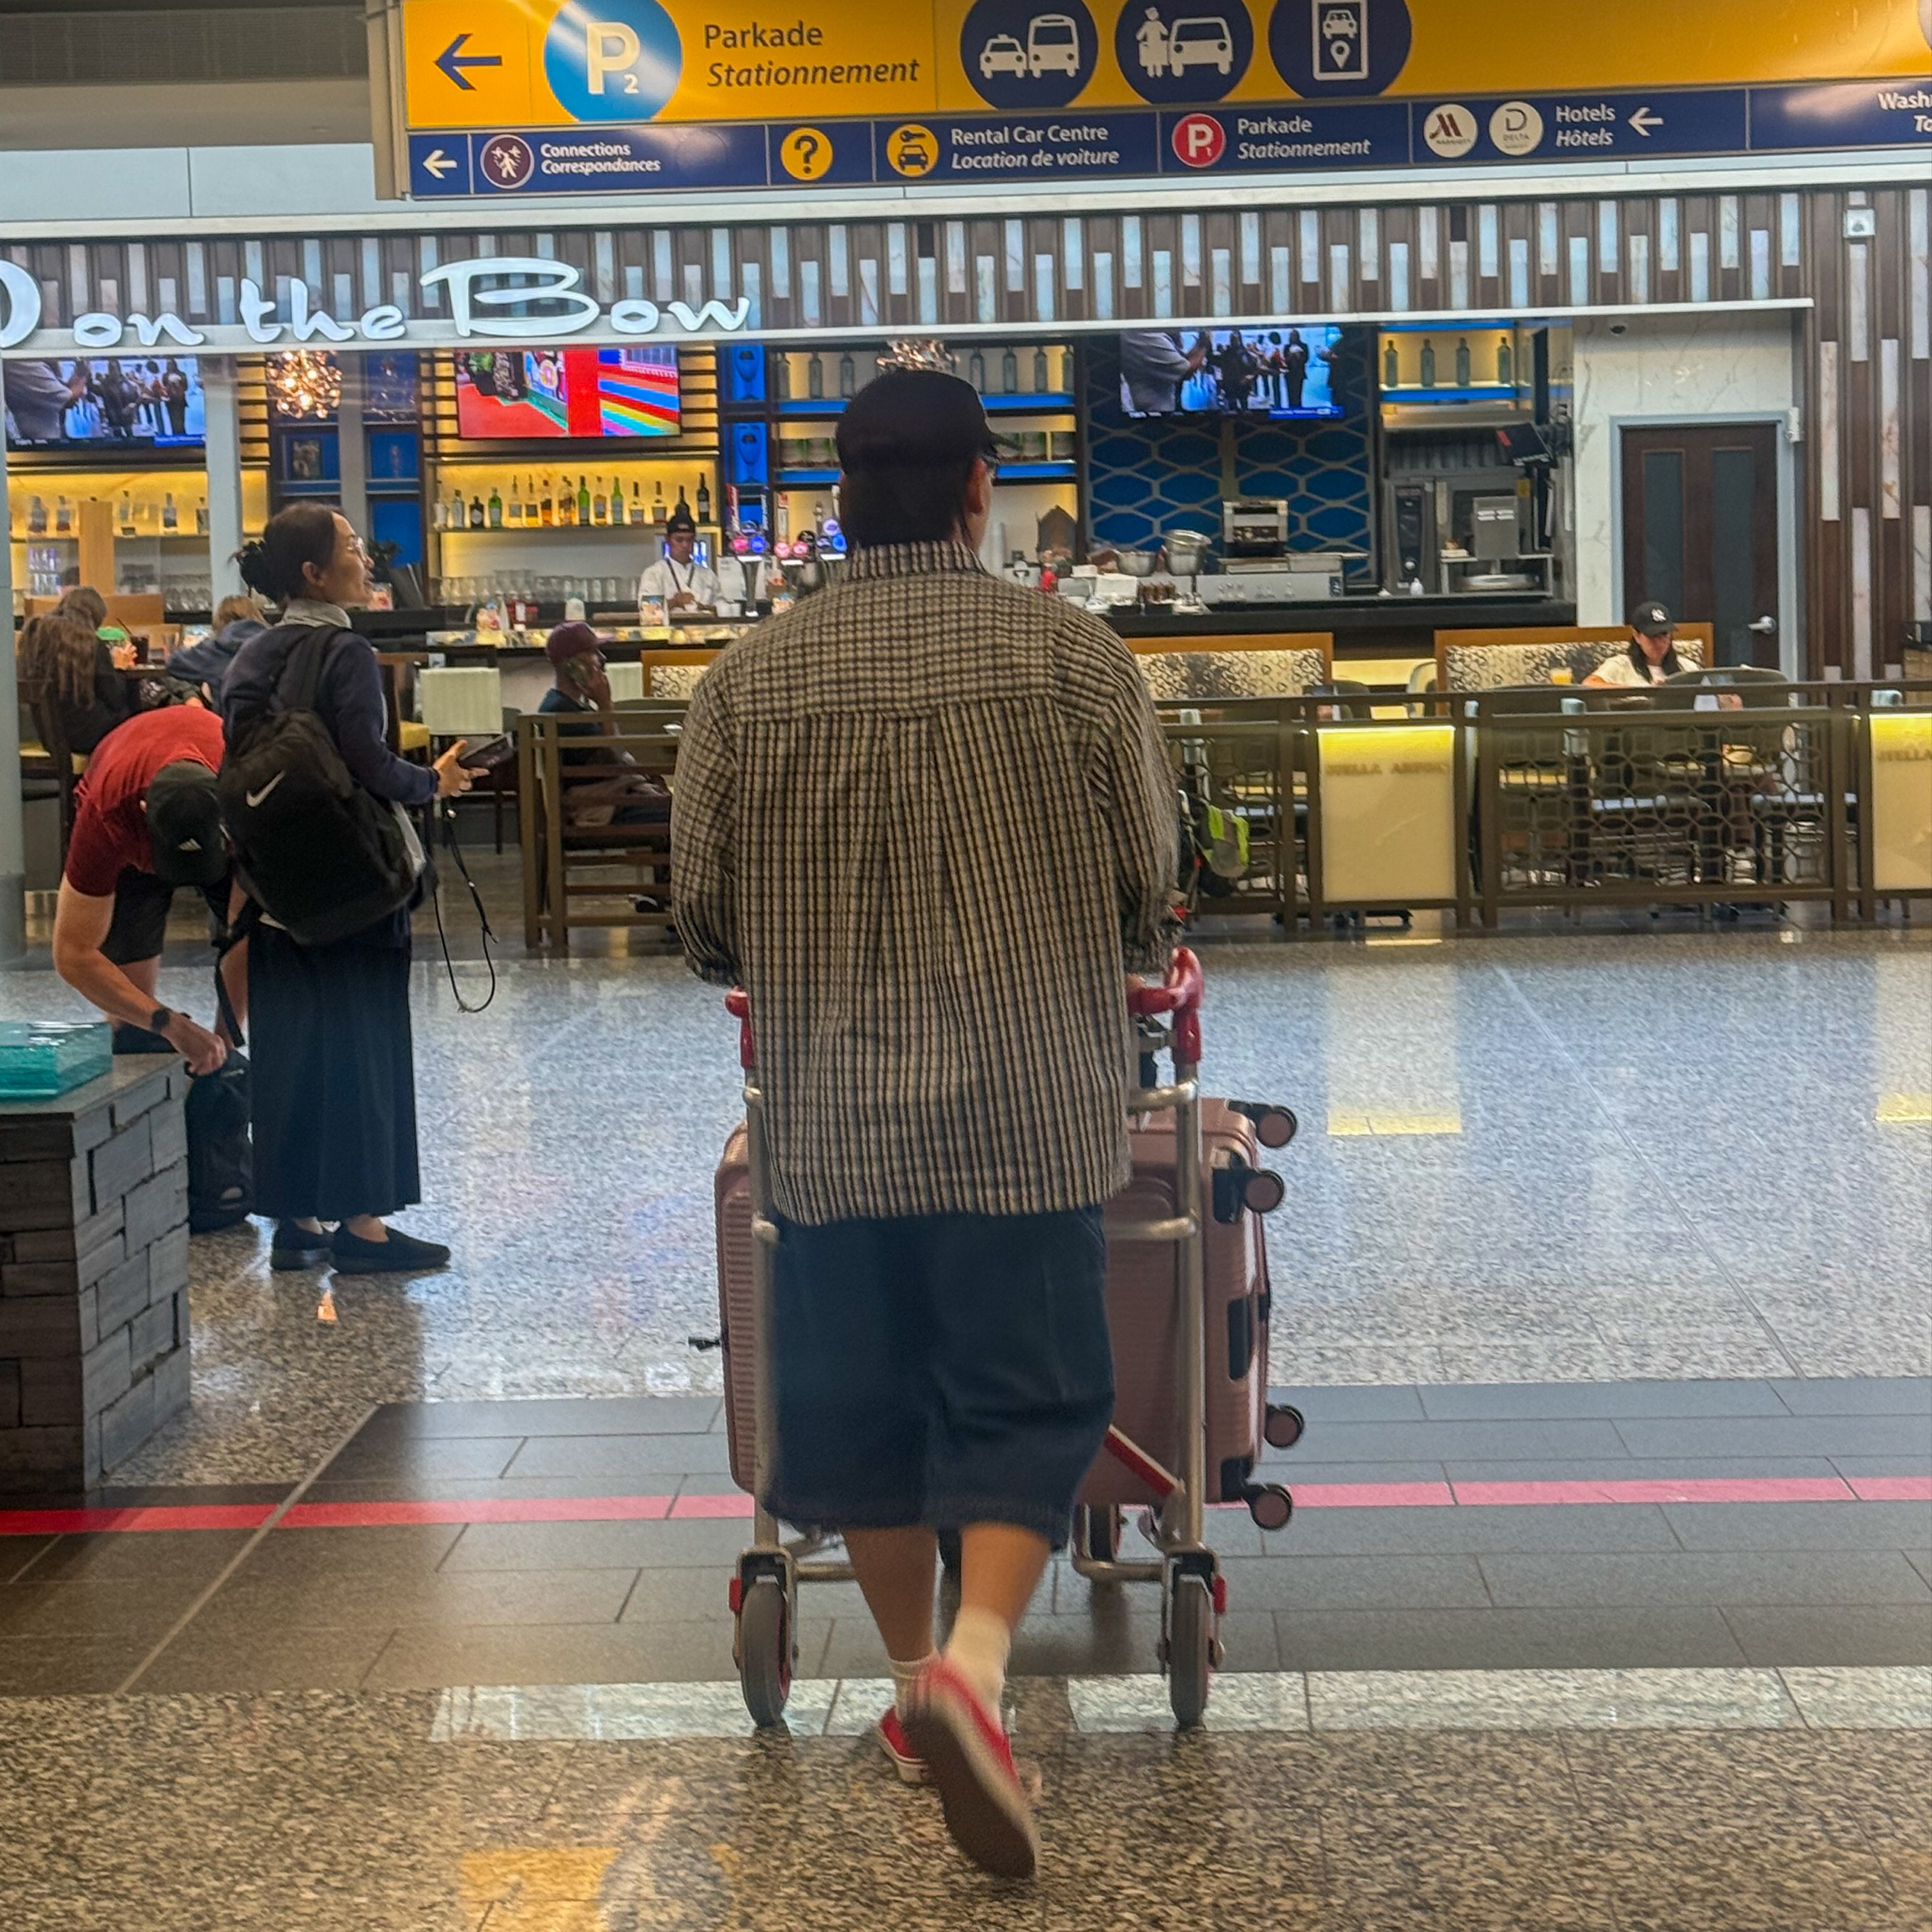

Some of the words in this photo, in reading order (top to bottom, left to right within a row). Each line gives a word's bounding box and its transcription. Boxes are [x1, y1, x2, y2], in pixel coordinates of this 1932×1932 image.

[704, 20, 823, 49] Parkade
[707, 59, 920, 88] Stationnement
[1877, 89, 1932, 110] Wash
[1555, 103, 1616, 123] Hotels
[951, 126, 1009, 146] Rental
[1013, 126, 1045, 143] Car
[1047, 124, 1109, 142] Centre
[1237, 115, 1313, 135] Parkade
[1555, 127, 1614, 148] Hôtels
[540, 142, 632, 158] Connections
[951, 149, 1027, 169] Location
[1031, 149, 1054, 166] de
[1057, 148, 1119, 165] voiture
[1237, 139, 1372, 160] Stationnement
[541, 158, 661, 176] Correspondances
[72, 312, 206, 348] on
[239, 277, 406, 343] the
[419, 257, 750, 337] Bow
